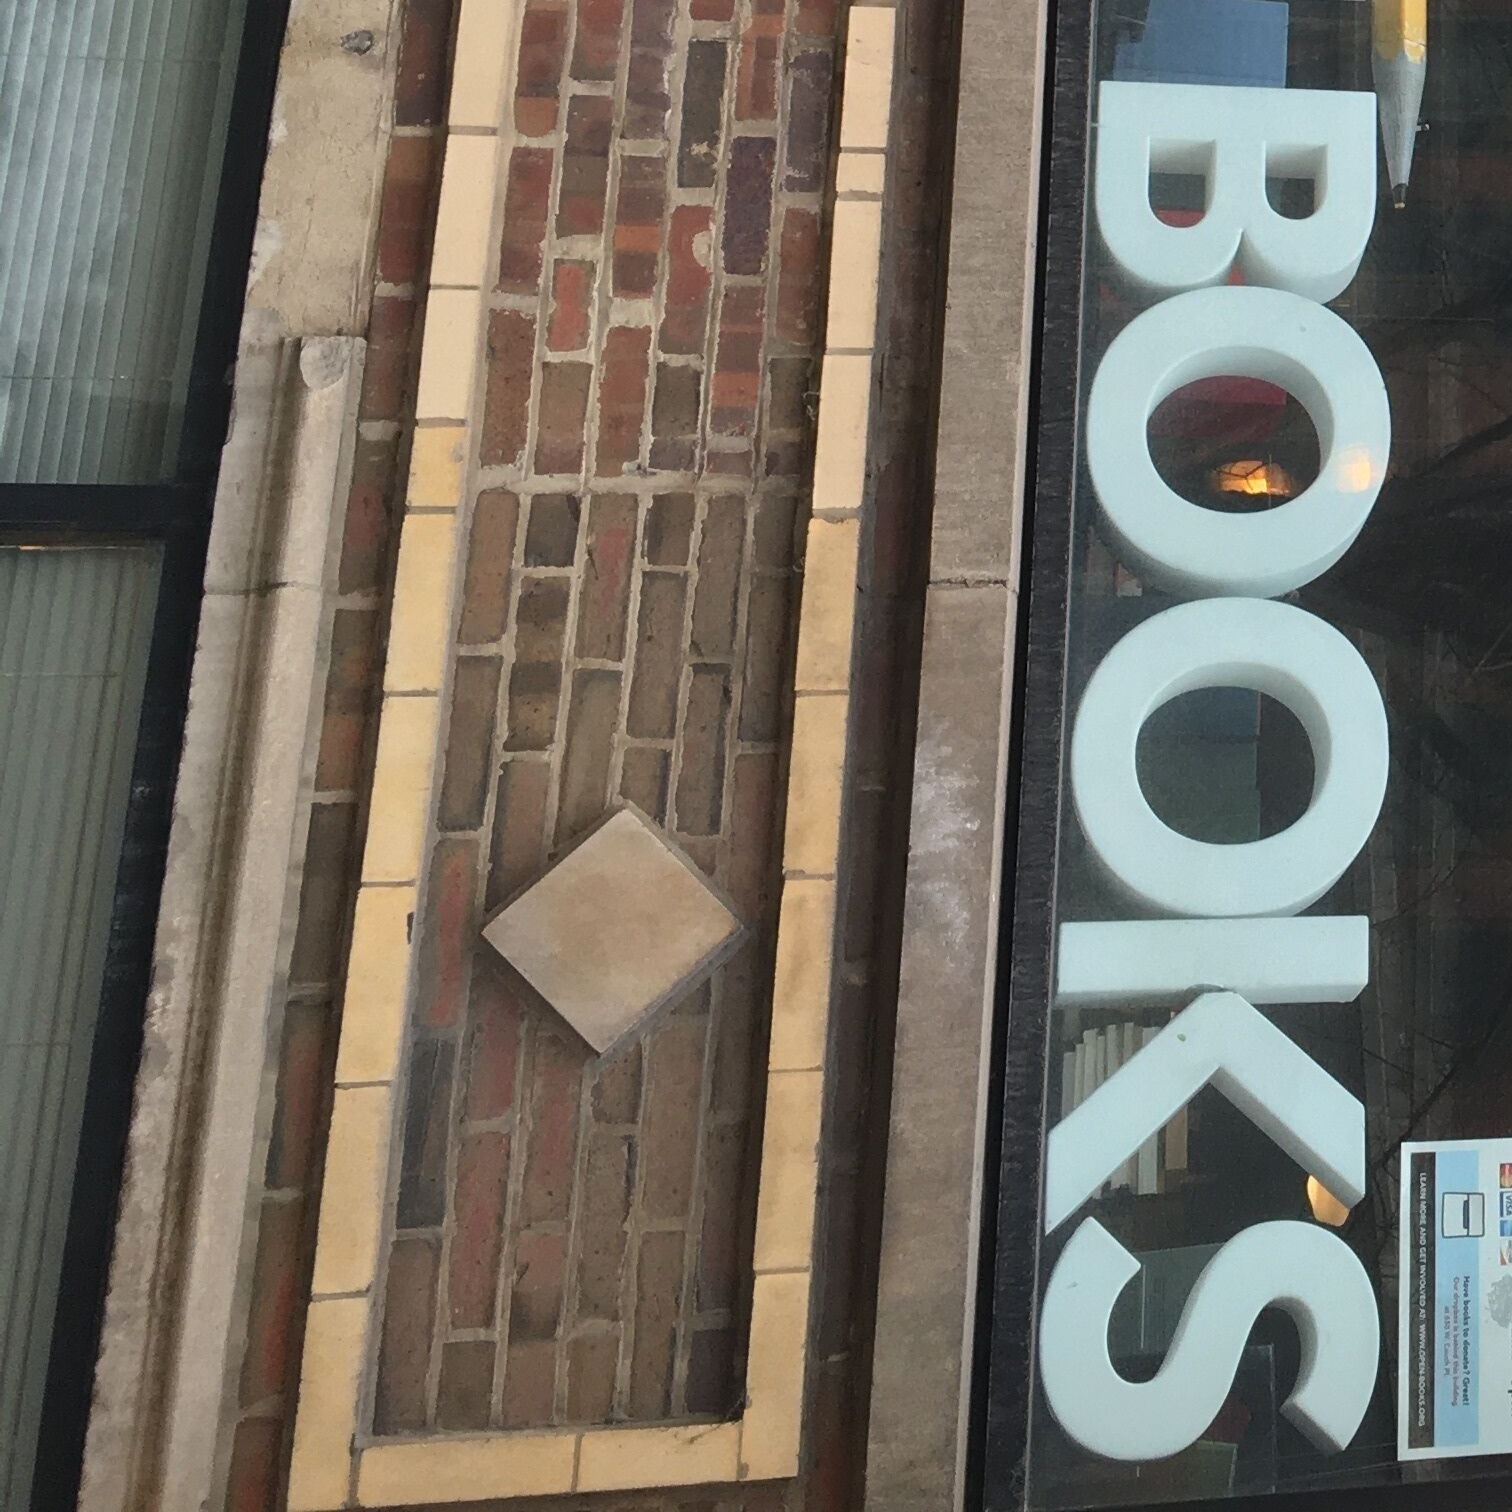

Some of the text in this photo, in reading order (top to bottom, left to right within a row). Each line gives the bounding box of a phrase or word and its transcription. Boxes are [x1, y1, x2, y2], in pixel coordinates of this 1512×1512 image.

[1040, 81, 1391, 1460] BOOKS
[1505, 1195, 1512, 1216] VISA
[1463, 1328, 1470, 1337] to
